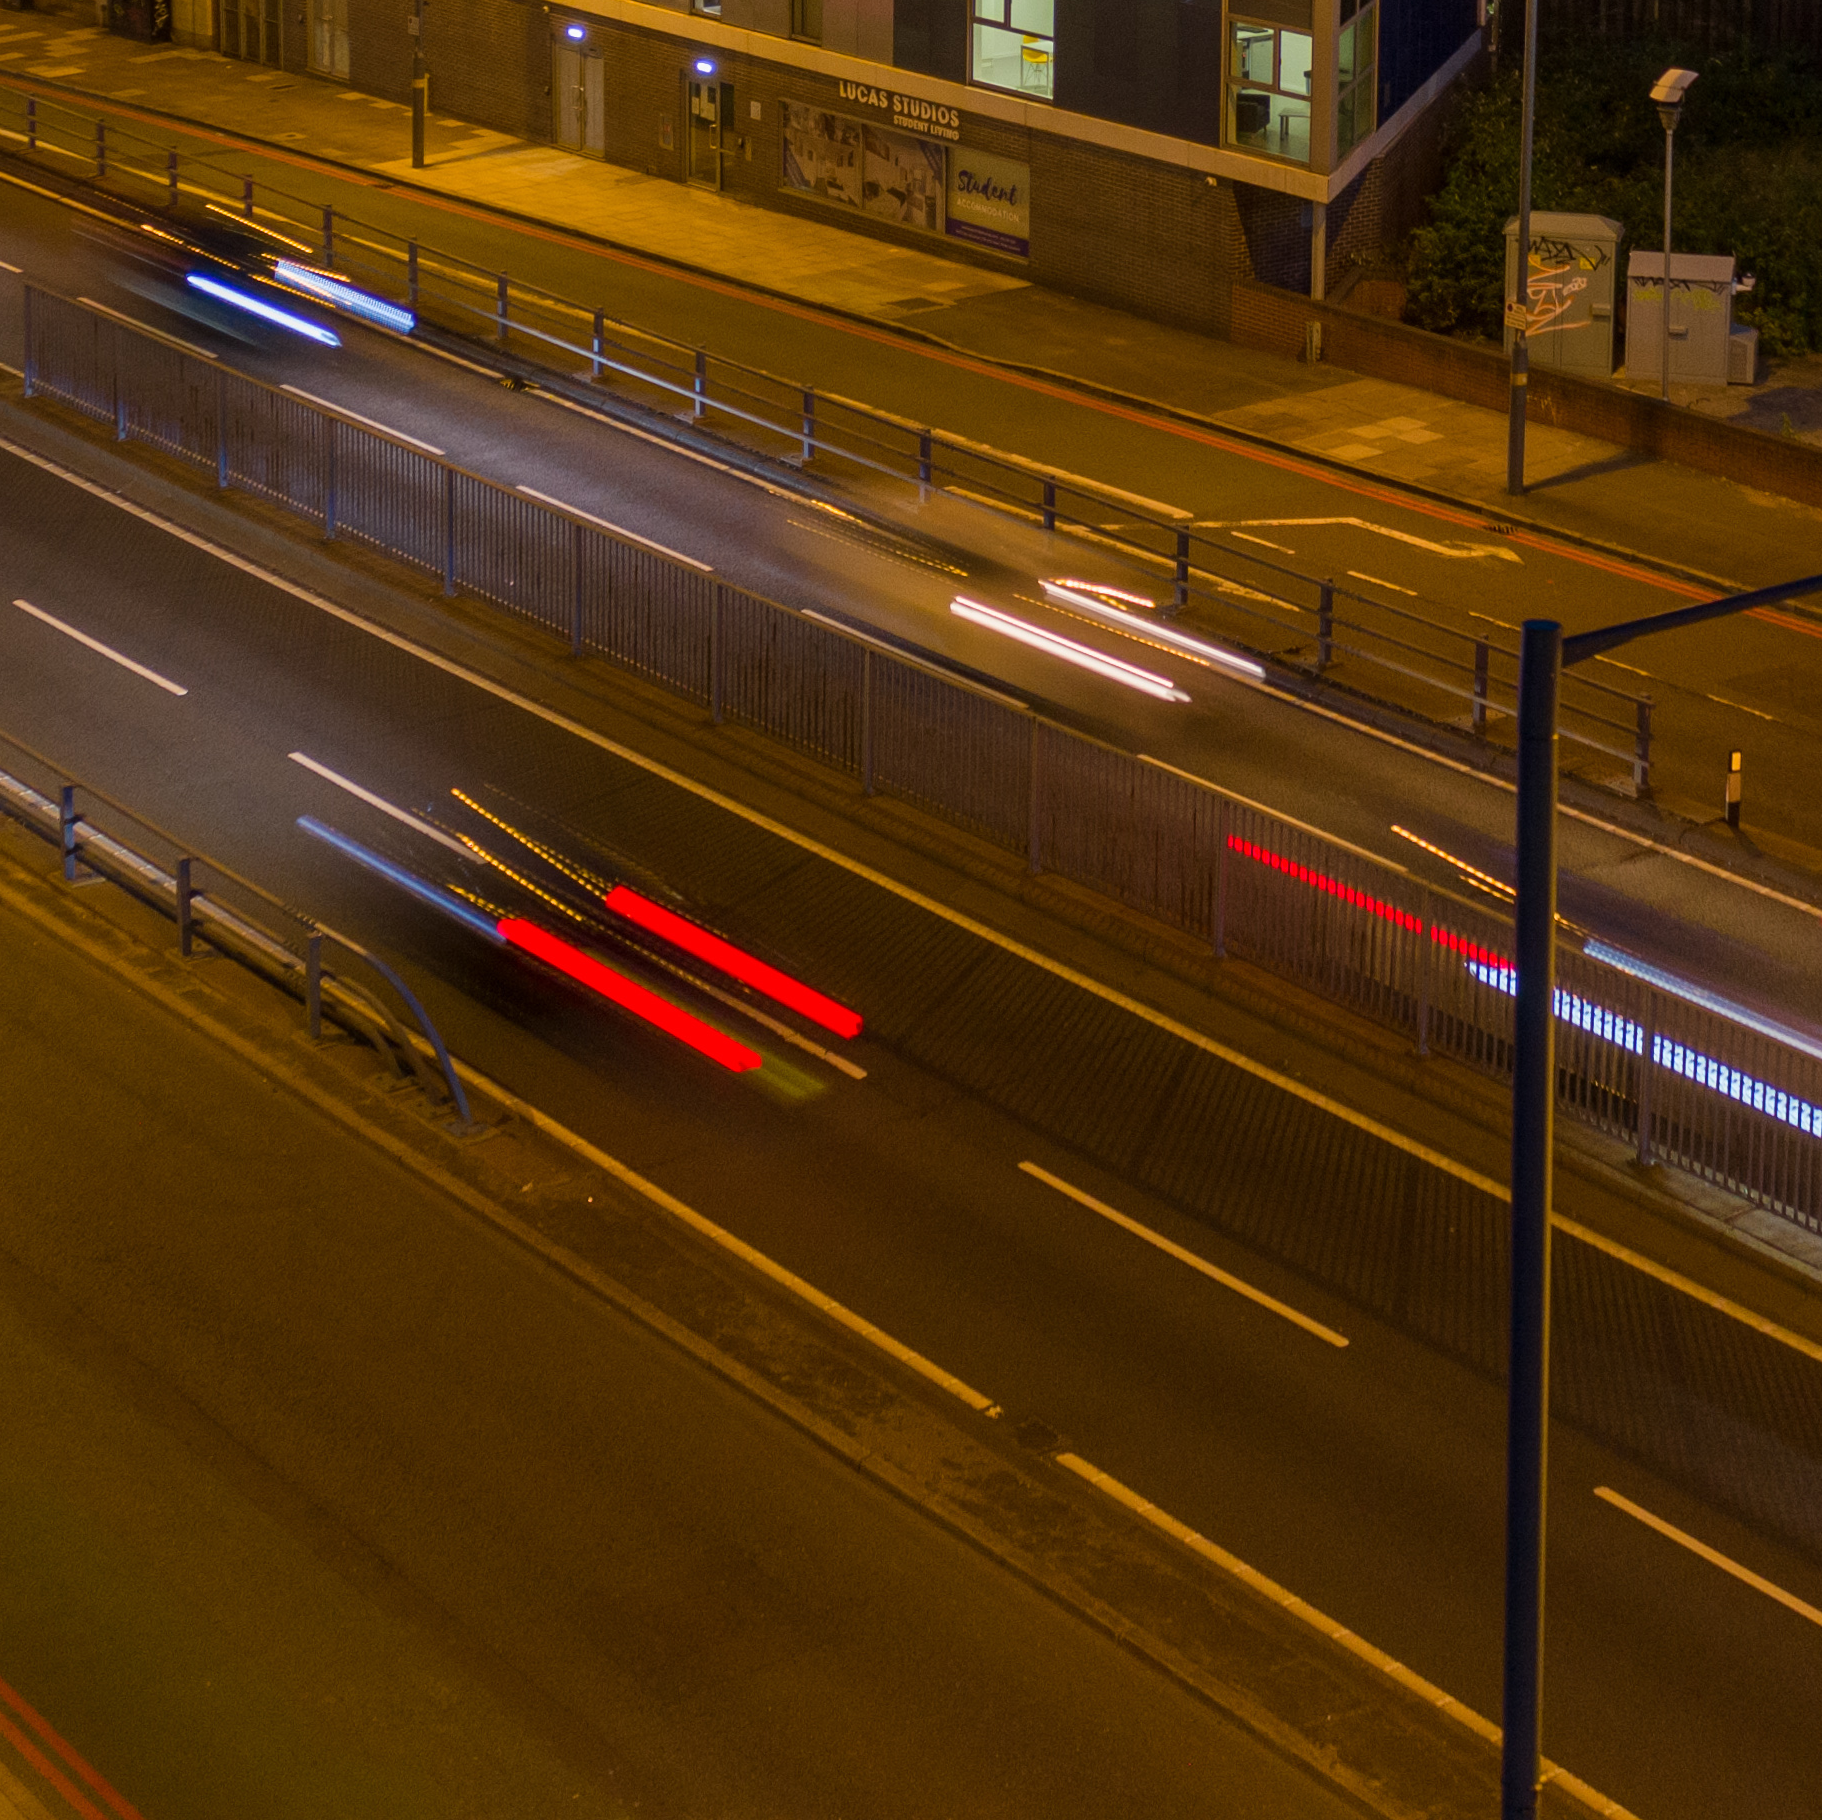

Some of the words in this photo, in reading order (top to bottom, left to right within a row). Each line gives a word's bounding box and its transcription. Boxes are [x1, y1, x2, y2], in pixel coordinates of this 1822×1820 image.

[839, 80, 888, 108] LUCAS
[893, 94, 960, 128] STUDIOS
[893, 114, 930, 134] STUDENT
[930, 124, 959, 141] LIVING
[958, 169, 1018, 206] Student
[957, 197, 1020, 222] ACCOMMODATION
